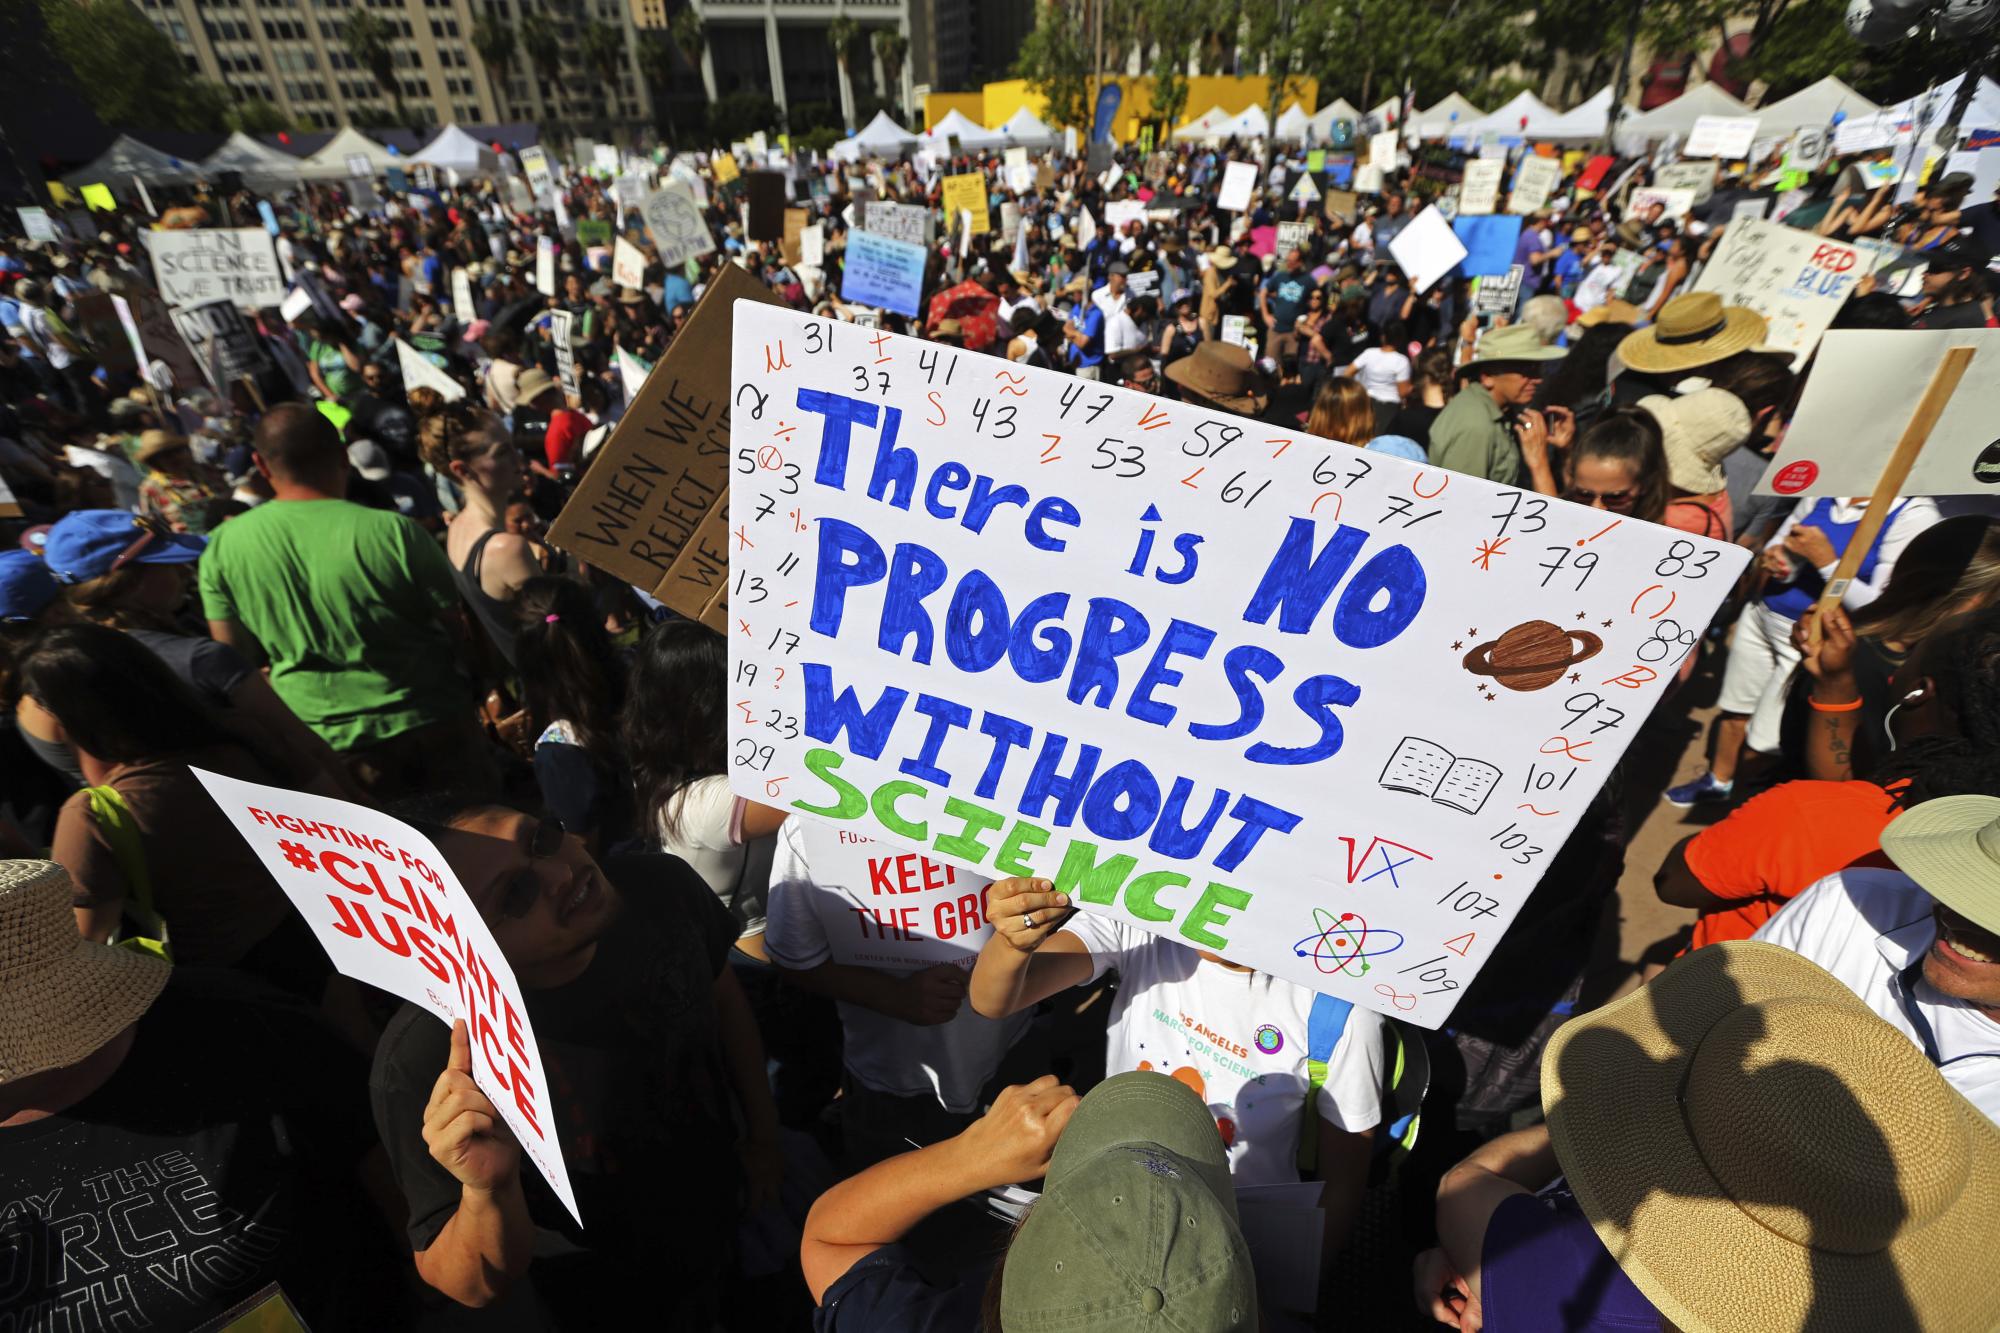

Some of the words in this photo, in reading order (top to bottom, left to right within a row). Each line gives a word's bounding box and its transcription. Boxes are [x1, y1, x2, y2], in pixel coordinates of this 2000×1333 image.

[187, 231, 242, 251] IN
[1809, 243, 1857, 273] RED
[159, 250, 270, 274] SCIENCE
[1793, 265, 1854, 299] BLUE
[162, 278, 211, 299] WE
[220, 275, 278, 295] TRUST
[178, 305, 241, 344] NO!
[803, 322, 833, 354] 31
[852, 365, 892, 396] 37
[919, 350, 958, 386] 41
[971, 397, 1018, 439] 43
[1060, 383, 1114, 424] 47
[1091, 438, 1146, 478] 53
[1181, 420, 1244, 459] 59
[574, 452, 669, 548] WHEN
[645, 379, 712, 445] WE
[1312, 455, 1373, 490] 67
[1220, 470, 1273, 509] 61
[628, 467, 716, 571] REJECT
[796, 387, 1080, 553] There
[1124, 502, 1206, 585] is
[1242, 515, 1427, 649] NO
[1490, 491, 1549, 539] 73
[678, 537, 730, 587] WE
[1538, 546, 1599, 592] 79
[1655, 539, 1721, 579] 83
[735, 569, 769, 604] 13
[767, 626, 801, 655] 17
[809, 516, 1362, 766] PROGRESS
[1636, 619, 1698, 667] 89
[736, 660, 758, 687] 19
[765, 709, 799, 740] 23
[1559, 692, 1626, 735] 97
[735, 737, 776, 772] 29
[800, 662, 1304, 873] WITHOUT
[1523, 763, 1578, 794] 101
[247, 806, 395, 861] FIGHTING
[397, 848, 448, 898] FOR
[791, 748, 1253, 951] SCIENCE
[1489, 822, 1544, 865] 103
[1436, 881, 1500, 920] 107
[849, 906, 924, 942] THE
[277, 838, 531, 1070] #CLIMATE
[1396, 955, 1460, 995] 109
[326, 894, 545, 1141] JUSTICE
[1187, 1035, 1212, 1056] FOR
[1212, 1051, 1268, 1087] SCIENCE
[1193, 1022, 1249, 1060] ANGELES
[81, 1149, 199, 1204] THE
